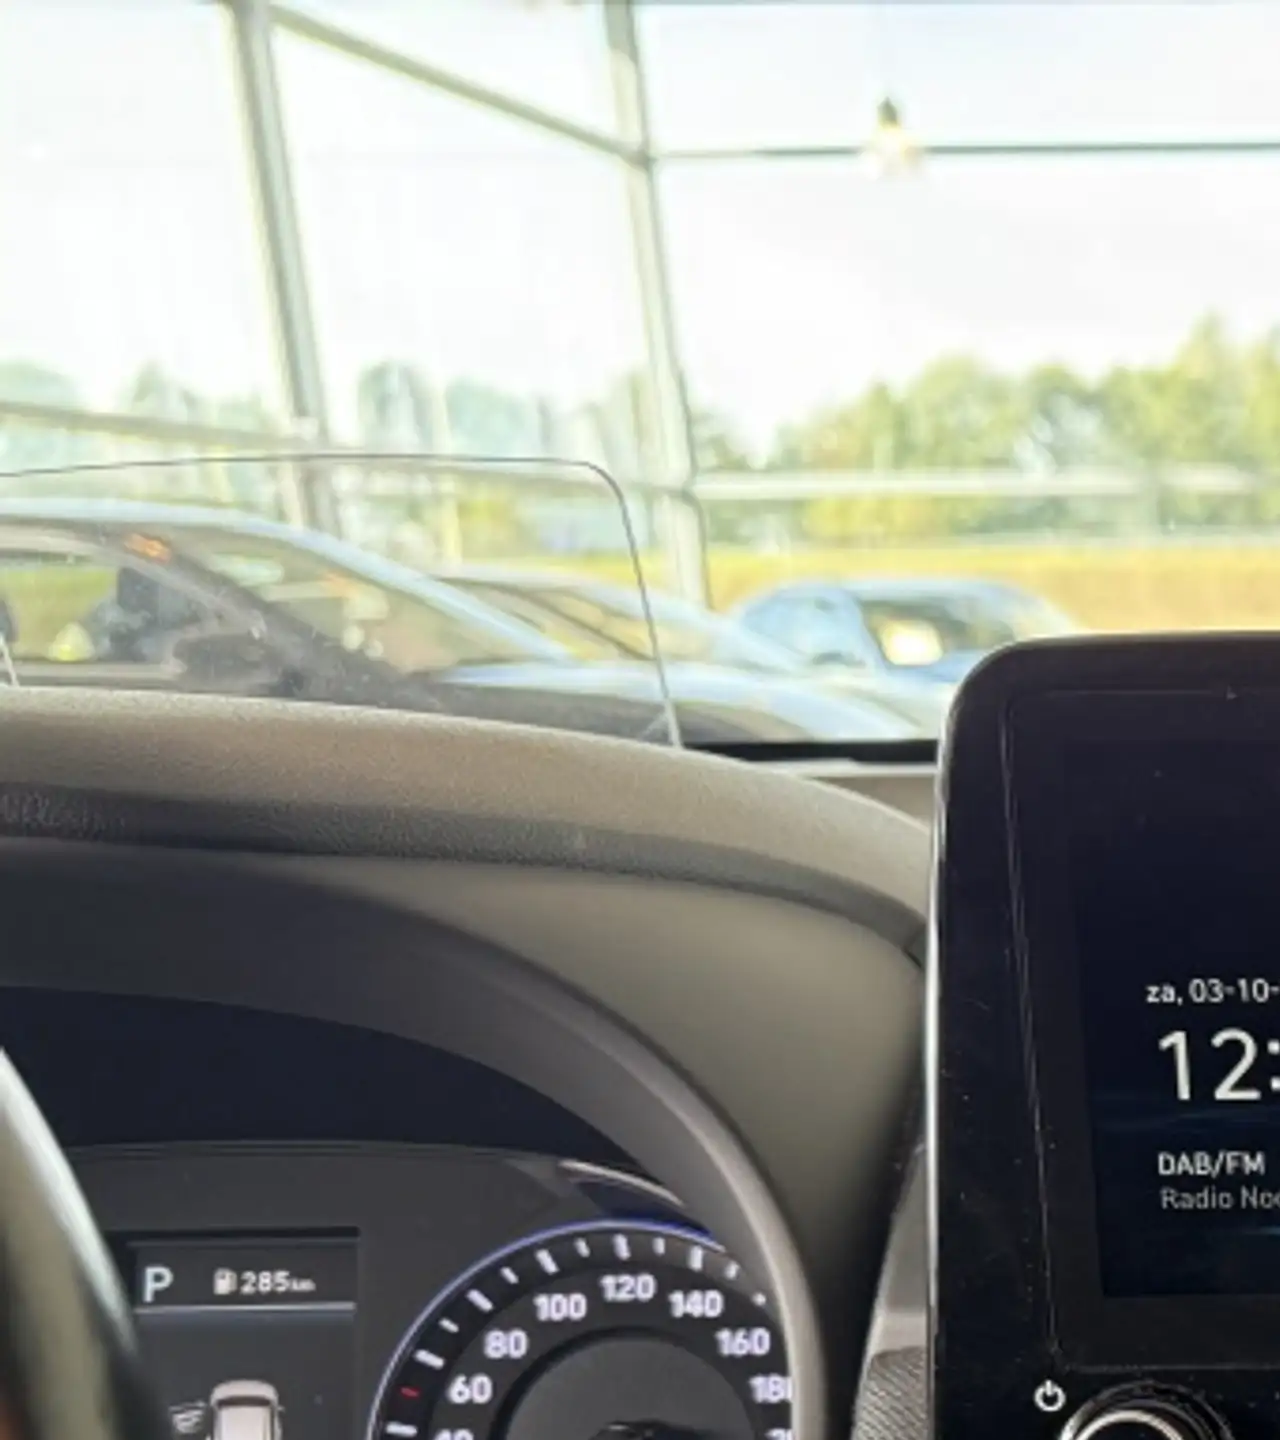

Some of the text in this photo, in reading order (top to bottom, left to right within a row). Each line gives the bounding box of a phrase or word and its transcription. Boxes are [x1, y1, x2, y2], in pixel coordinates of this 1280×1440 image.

[1146, 985, 1182, 1006] za,
[1158, 1151, 1265, 1178] DAB/FM
[1161, 1186, 1232, 1209] Radio
[143, 1265, 173, 1302] P
[600, 1274, 655, 1301] 120
[533, 1294, 587, 1322] 100
[668, 1290, 723, 1318] 140
[483, 1330, 527, 1358] 80
[715, 1328, 770, 1356] 160
[447, 1375, 492, 1404] 60
